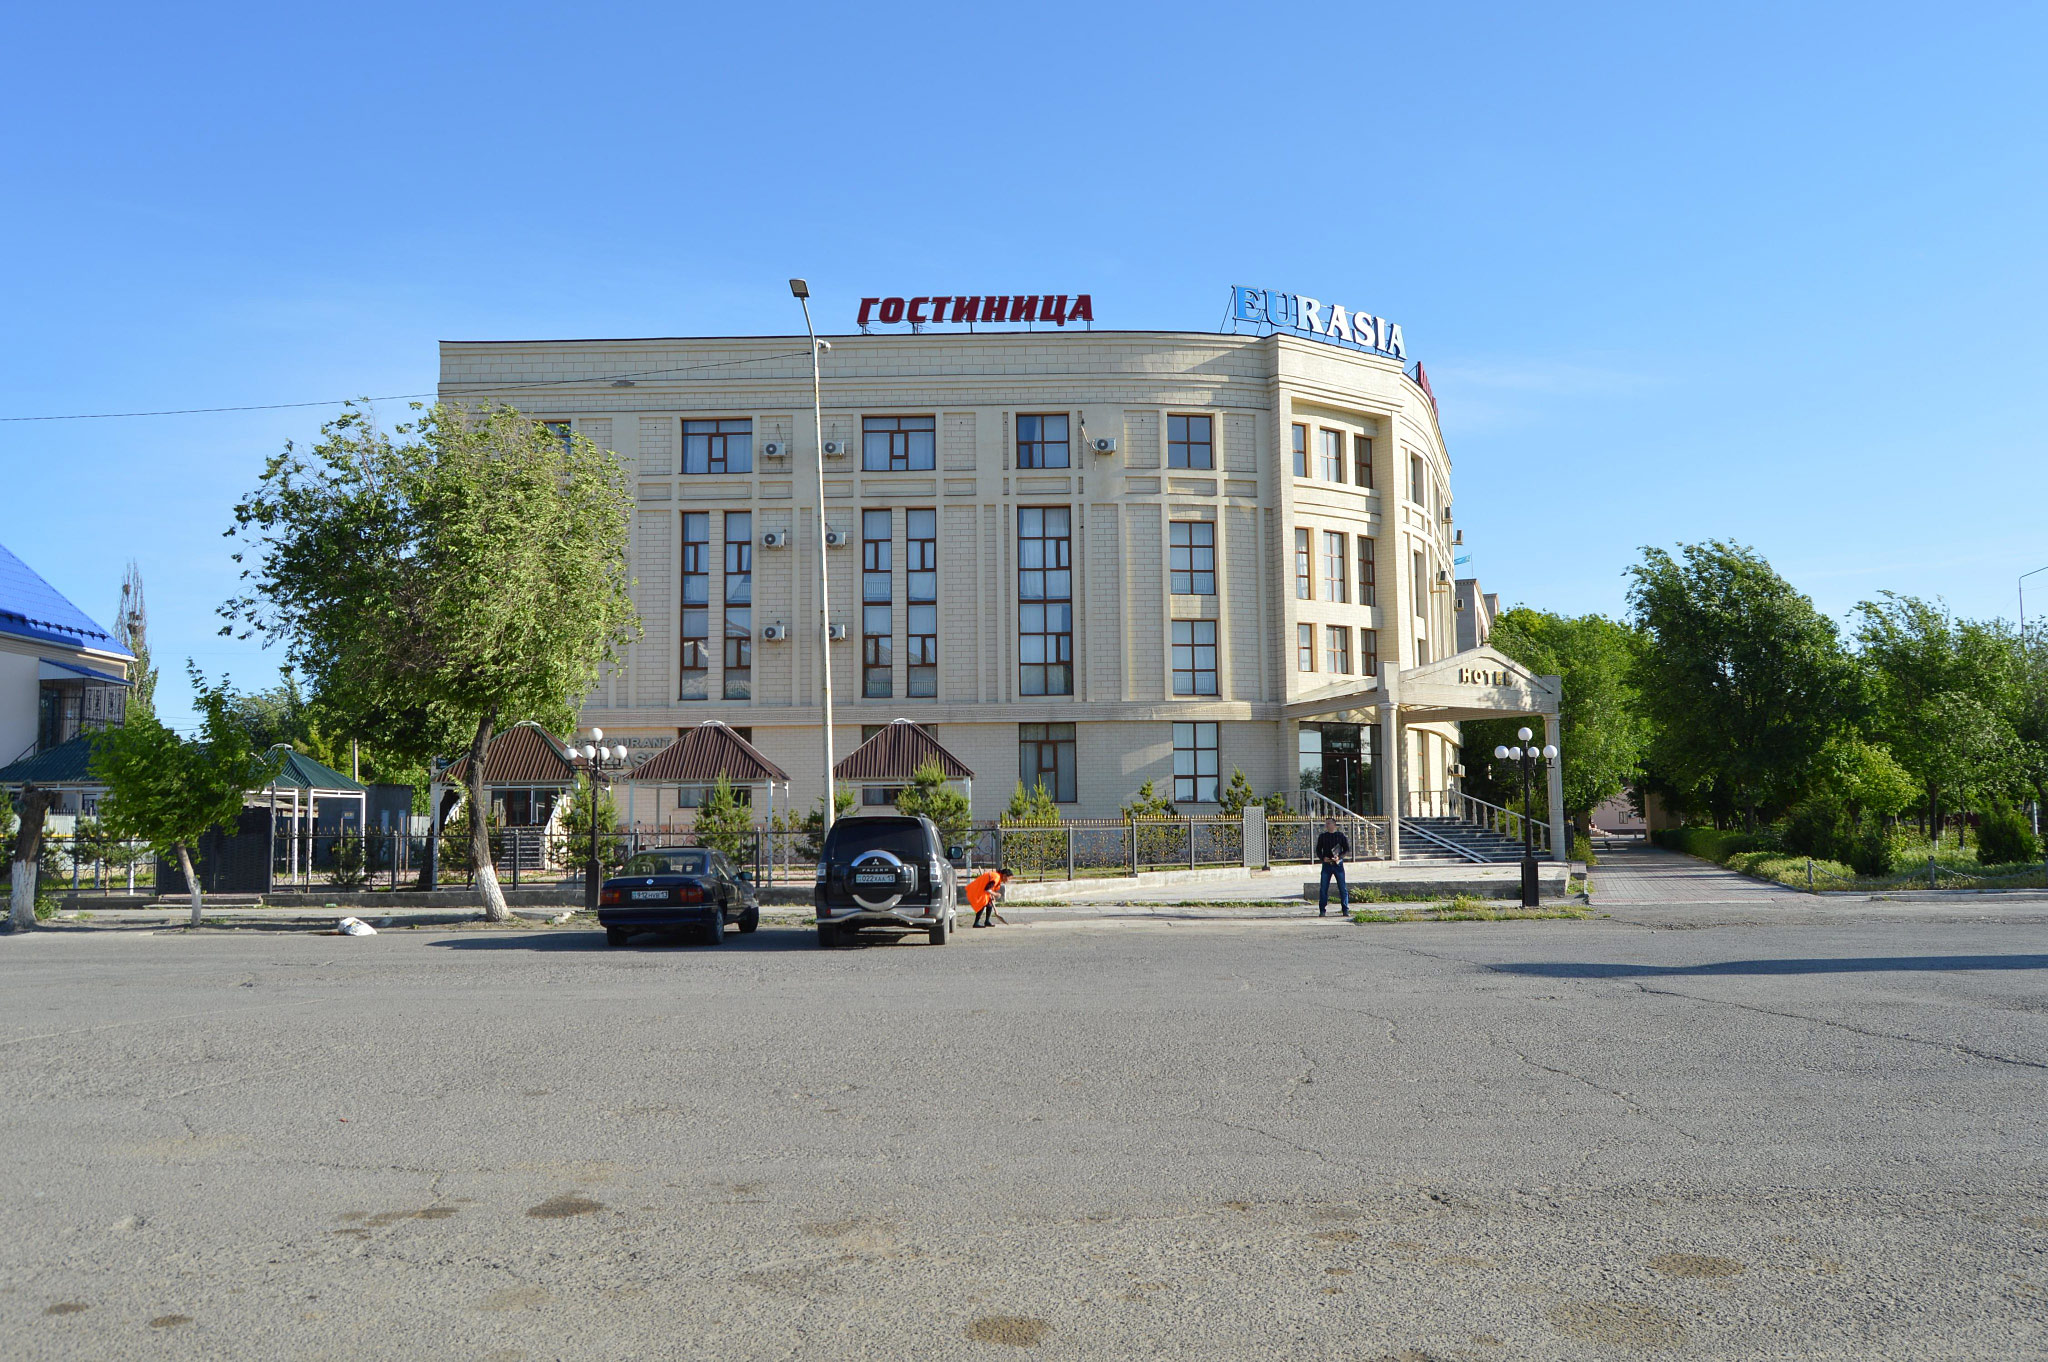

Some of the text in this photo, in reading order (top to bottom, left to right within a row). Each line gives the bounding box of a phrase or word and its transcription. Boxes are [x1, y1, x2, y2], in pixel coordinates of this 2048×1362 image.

[857, 294, 1094, 327] ГОСТИНИЦА
[1231, 284, 1408, 360] EURASIA
[1458, 668, 1512, 686] HOTEL
